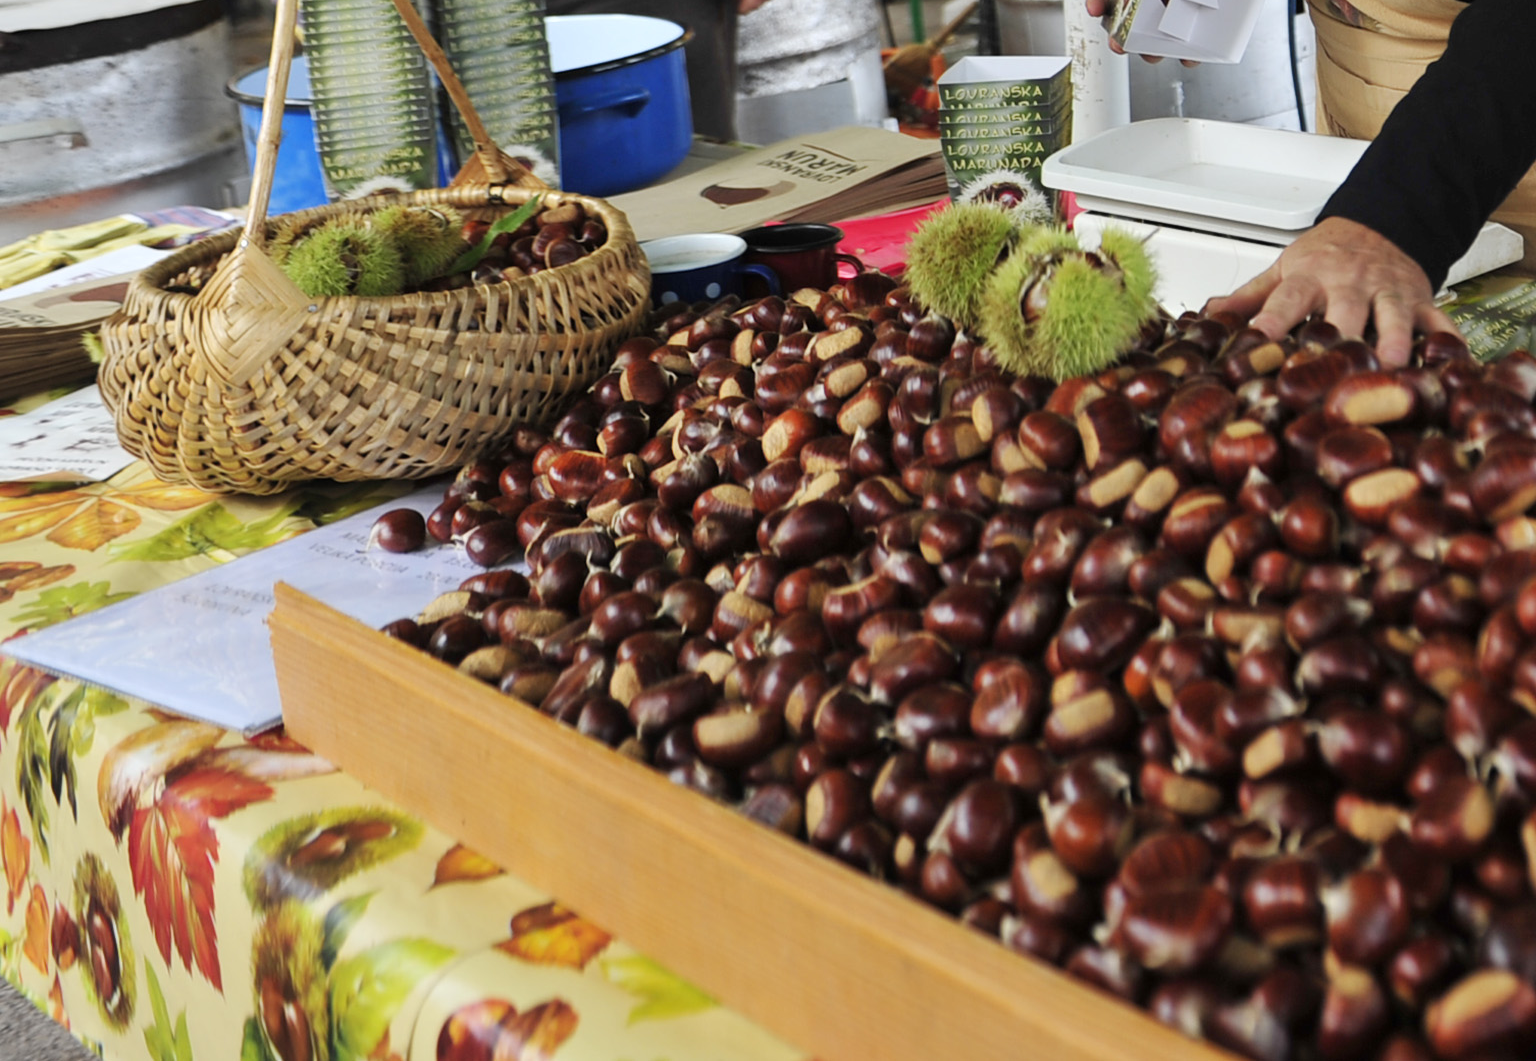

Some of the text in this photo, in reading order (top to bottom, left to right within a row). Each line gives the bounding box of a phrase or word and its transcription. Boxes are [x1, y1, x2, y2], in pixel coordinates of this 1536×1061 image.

[944, 85, 1043, 100] LOVRANSKA
[947, 141, 1045, 156] LOVRANSKA
[775, 149, 869, 176] MARUN
[953, 157, 1042, 170] MARUNADA
[757, 158, 844, 184] LOVRANSKI
